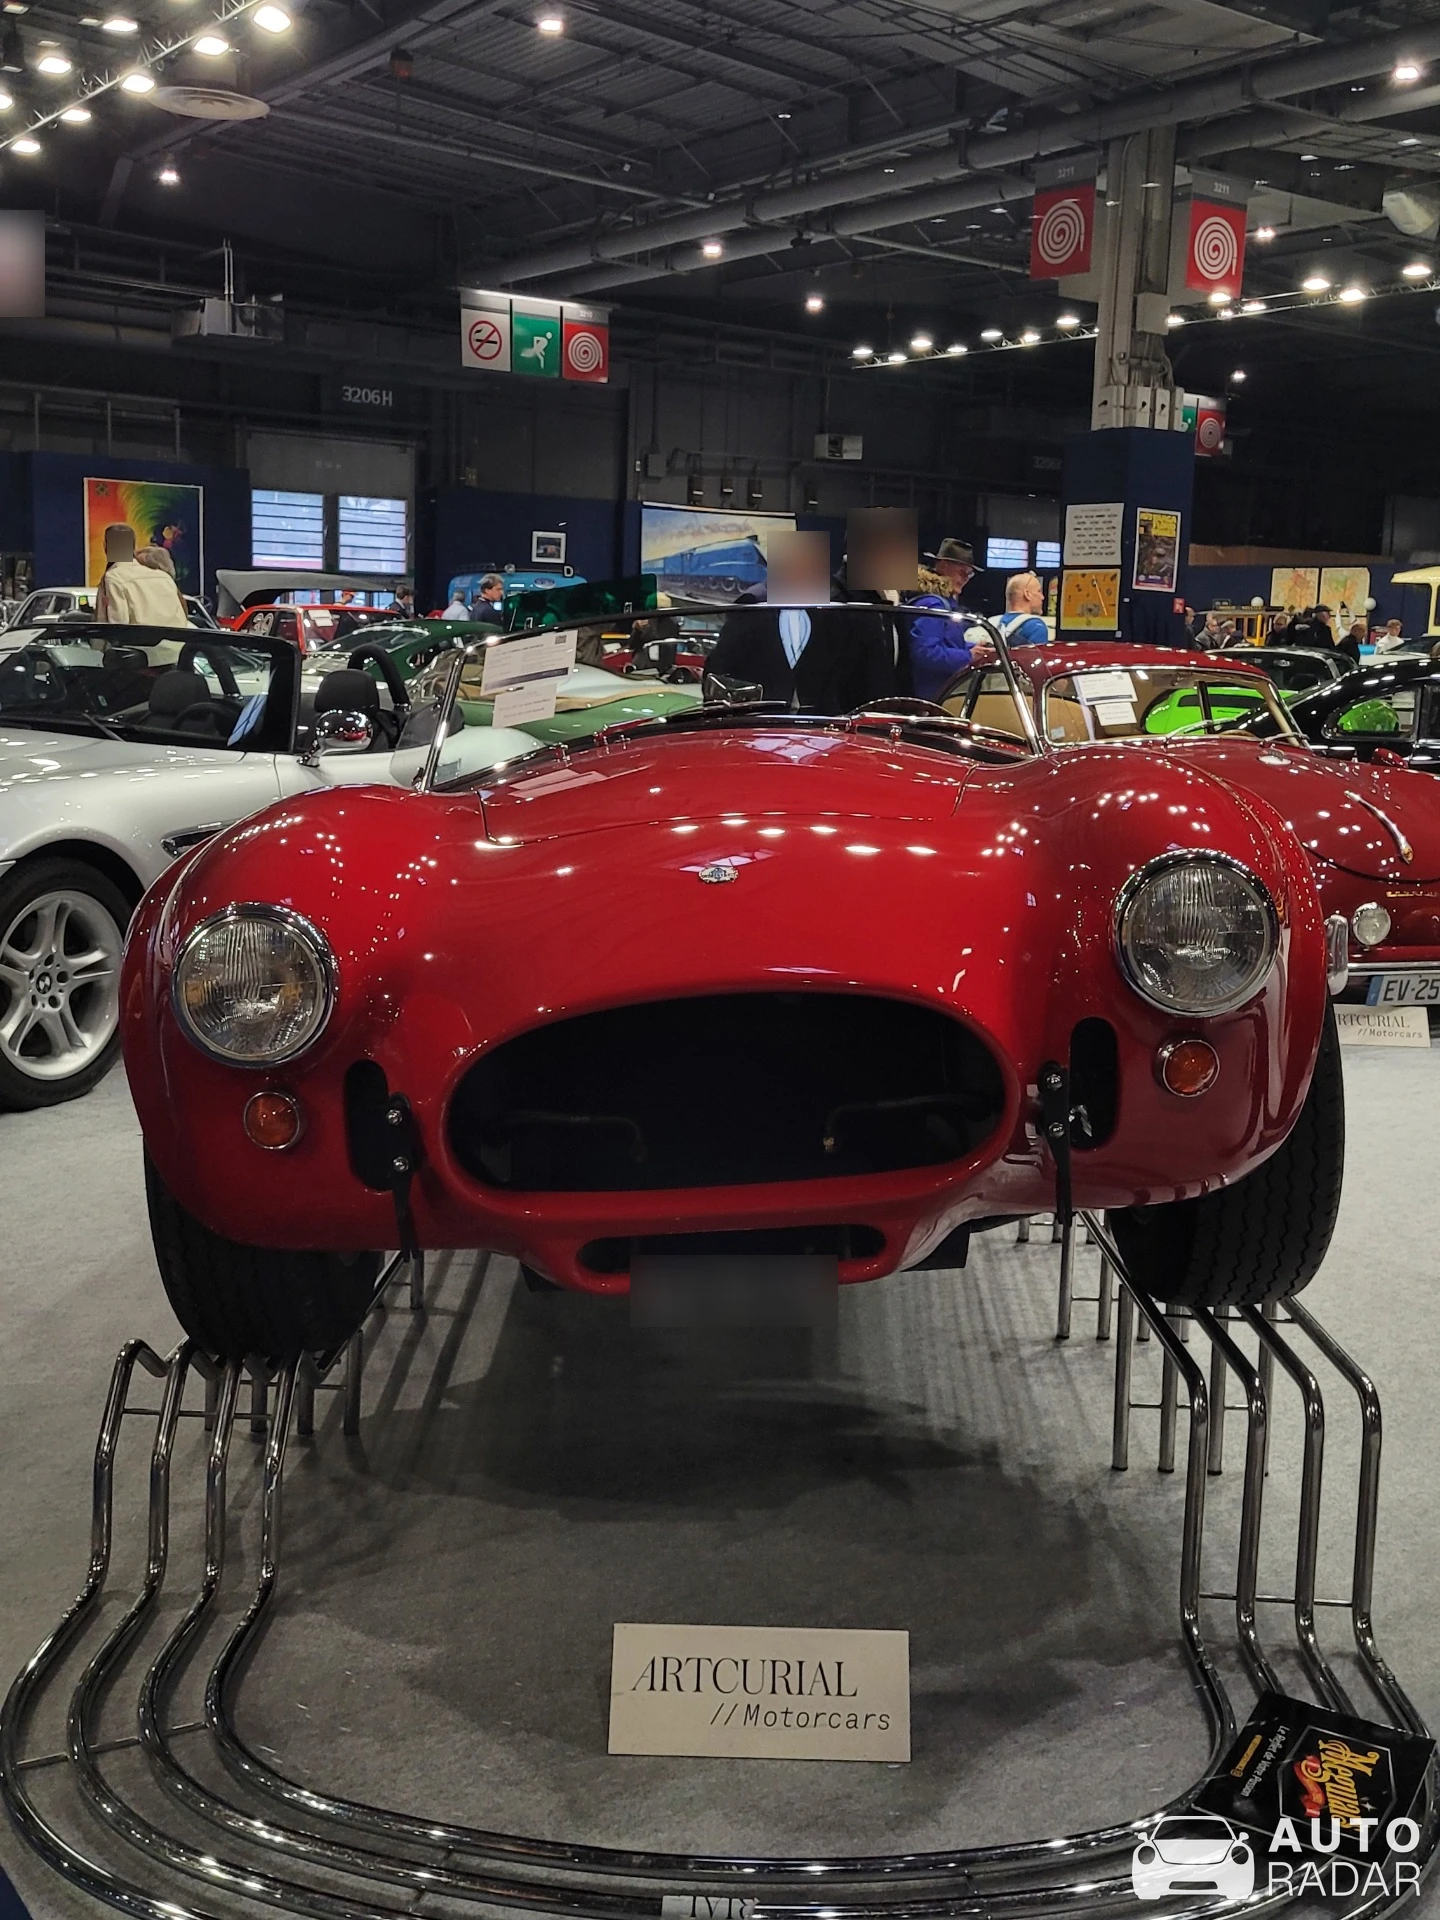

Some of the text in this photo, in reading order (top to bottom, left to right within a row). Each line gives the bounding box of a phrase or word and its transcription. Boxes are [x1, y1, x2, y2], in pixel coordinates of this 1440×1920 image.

[1212, 182, 1230, 195] 3211
[341, 385, 393, 407] 3206H
[1337, 1013, 1410, 1028] RTCURIAL
[631, 1655, 858, 1697] ARTCURIAL
